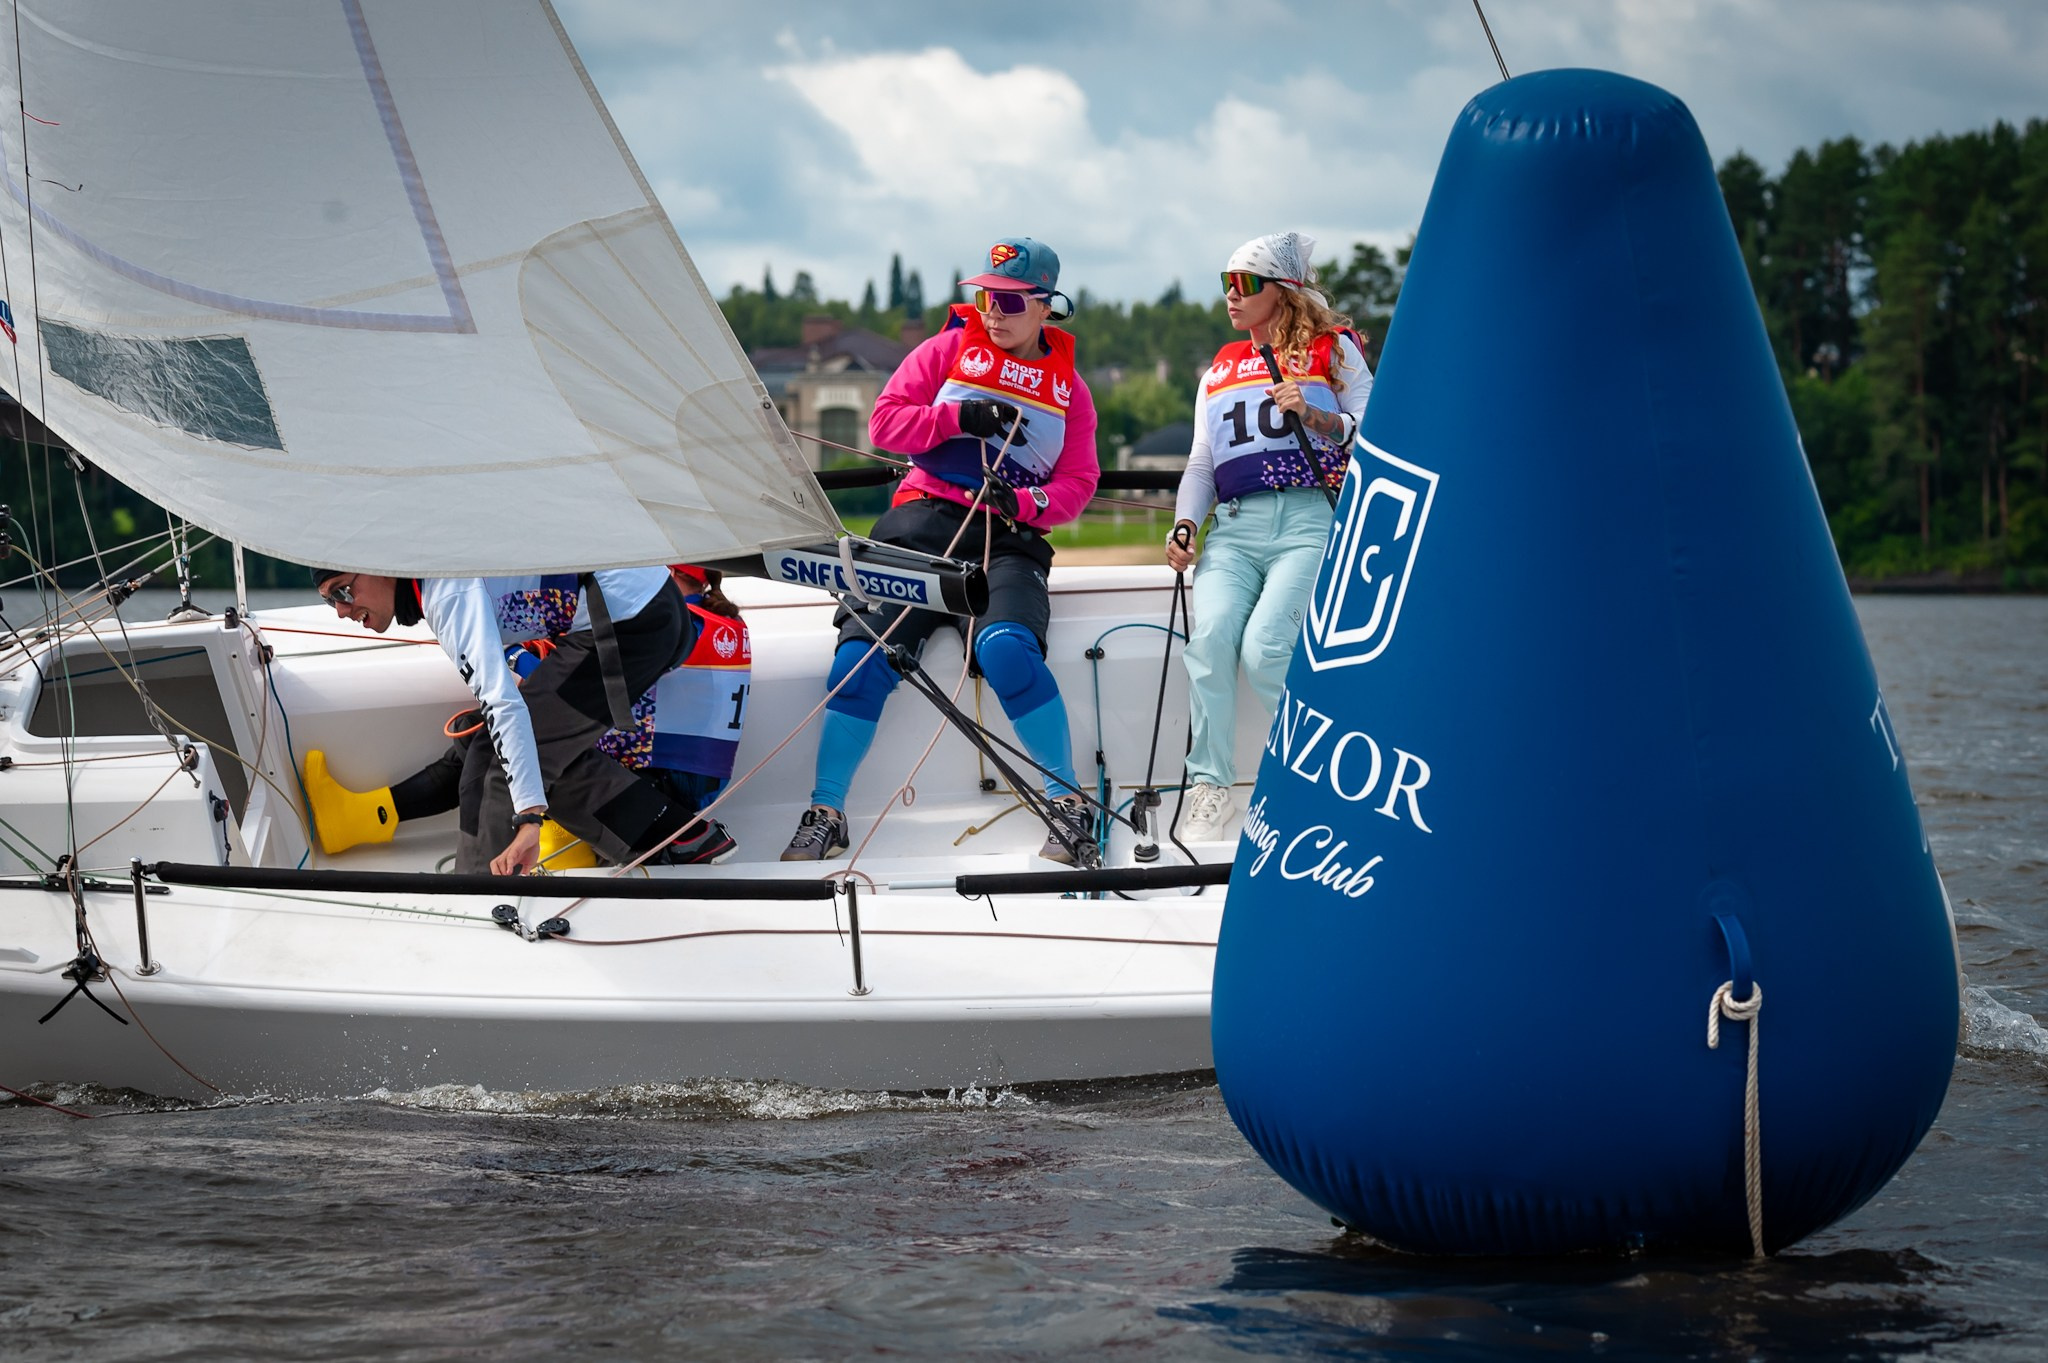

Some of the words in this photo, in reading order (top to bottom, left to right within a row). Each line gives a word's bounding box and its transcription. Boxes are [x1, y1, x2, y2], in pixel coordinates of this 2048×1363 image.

[999, 379, 1041, 397] sportmsu.ru
[1000, 365, 1043, 389] МГУ
[1222, 397, 1295, 448] 10
[780, 557, 831, 586] SNF
[1280, 825, 1383, 898] Club
